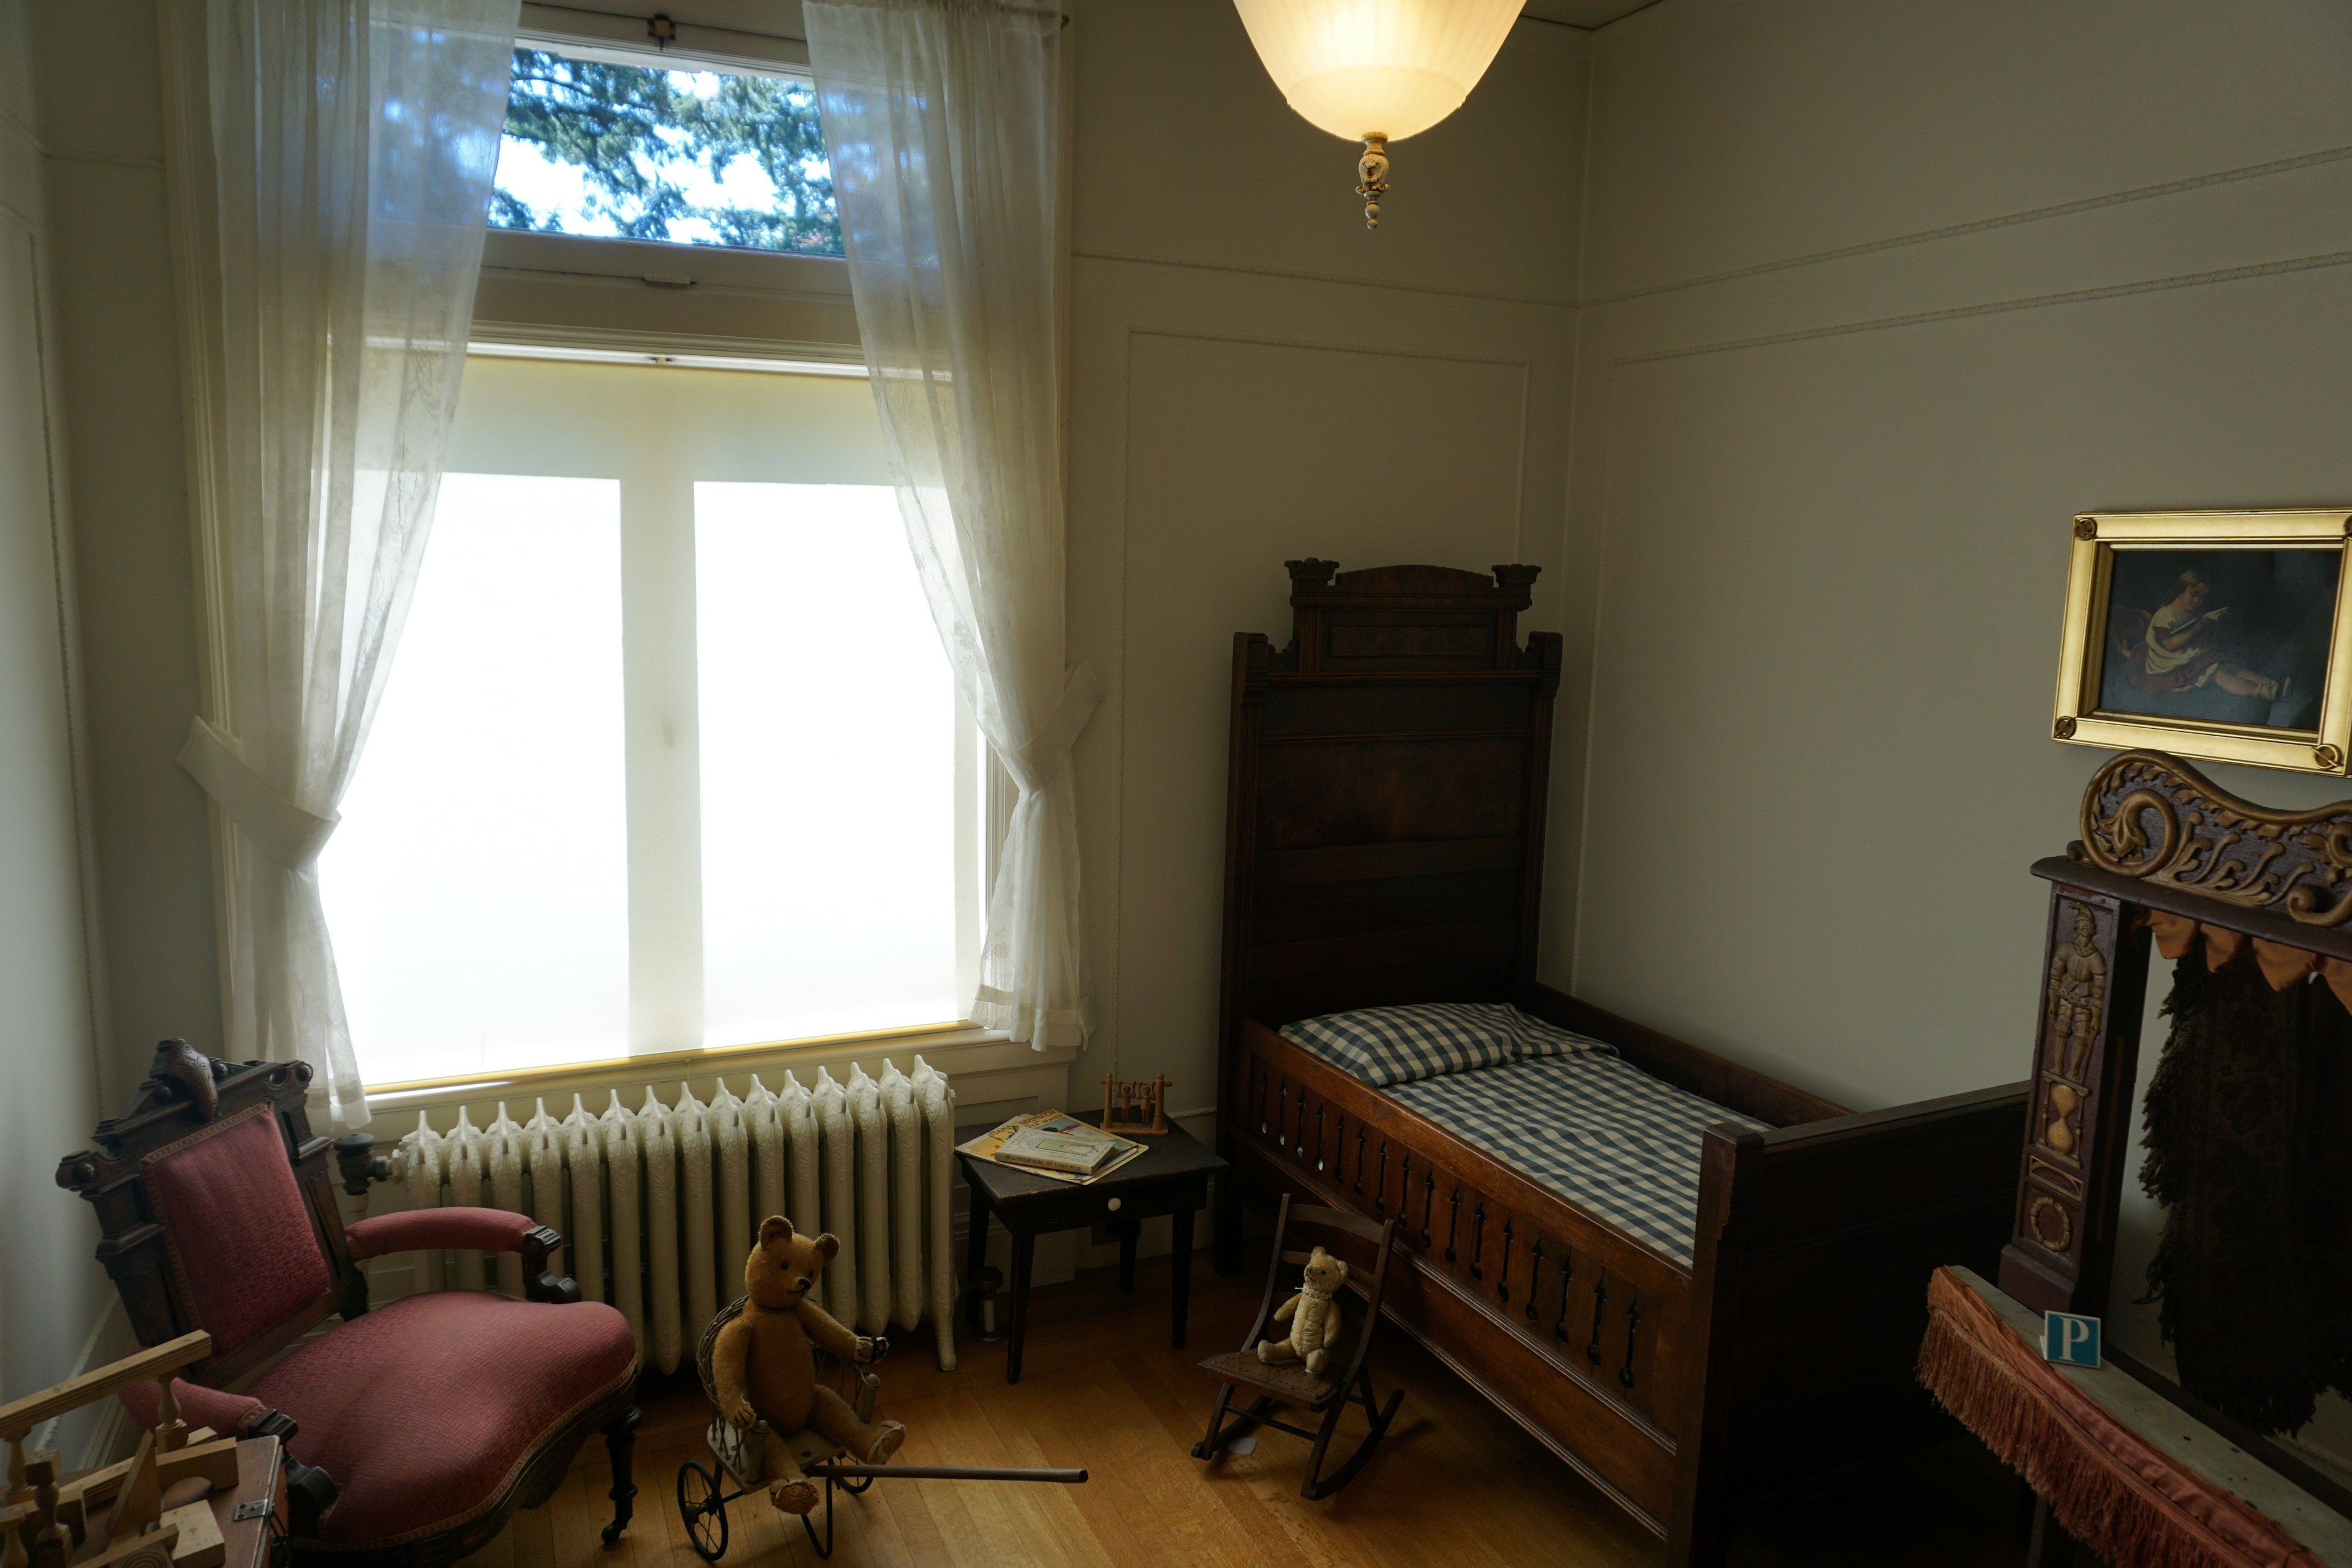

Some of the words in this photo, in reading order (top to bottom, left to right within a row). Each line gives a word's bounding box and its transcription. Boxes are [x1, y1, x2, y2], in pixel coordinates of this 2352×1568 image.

[1019, 1110, 1056, 1125] BRINKER
[1041, 1114, 1063, 1124] SKATES
[2059, 1316, 2089, 1362] P
